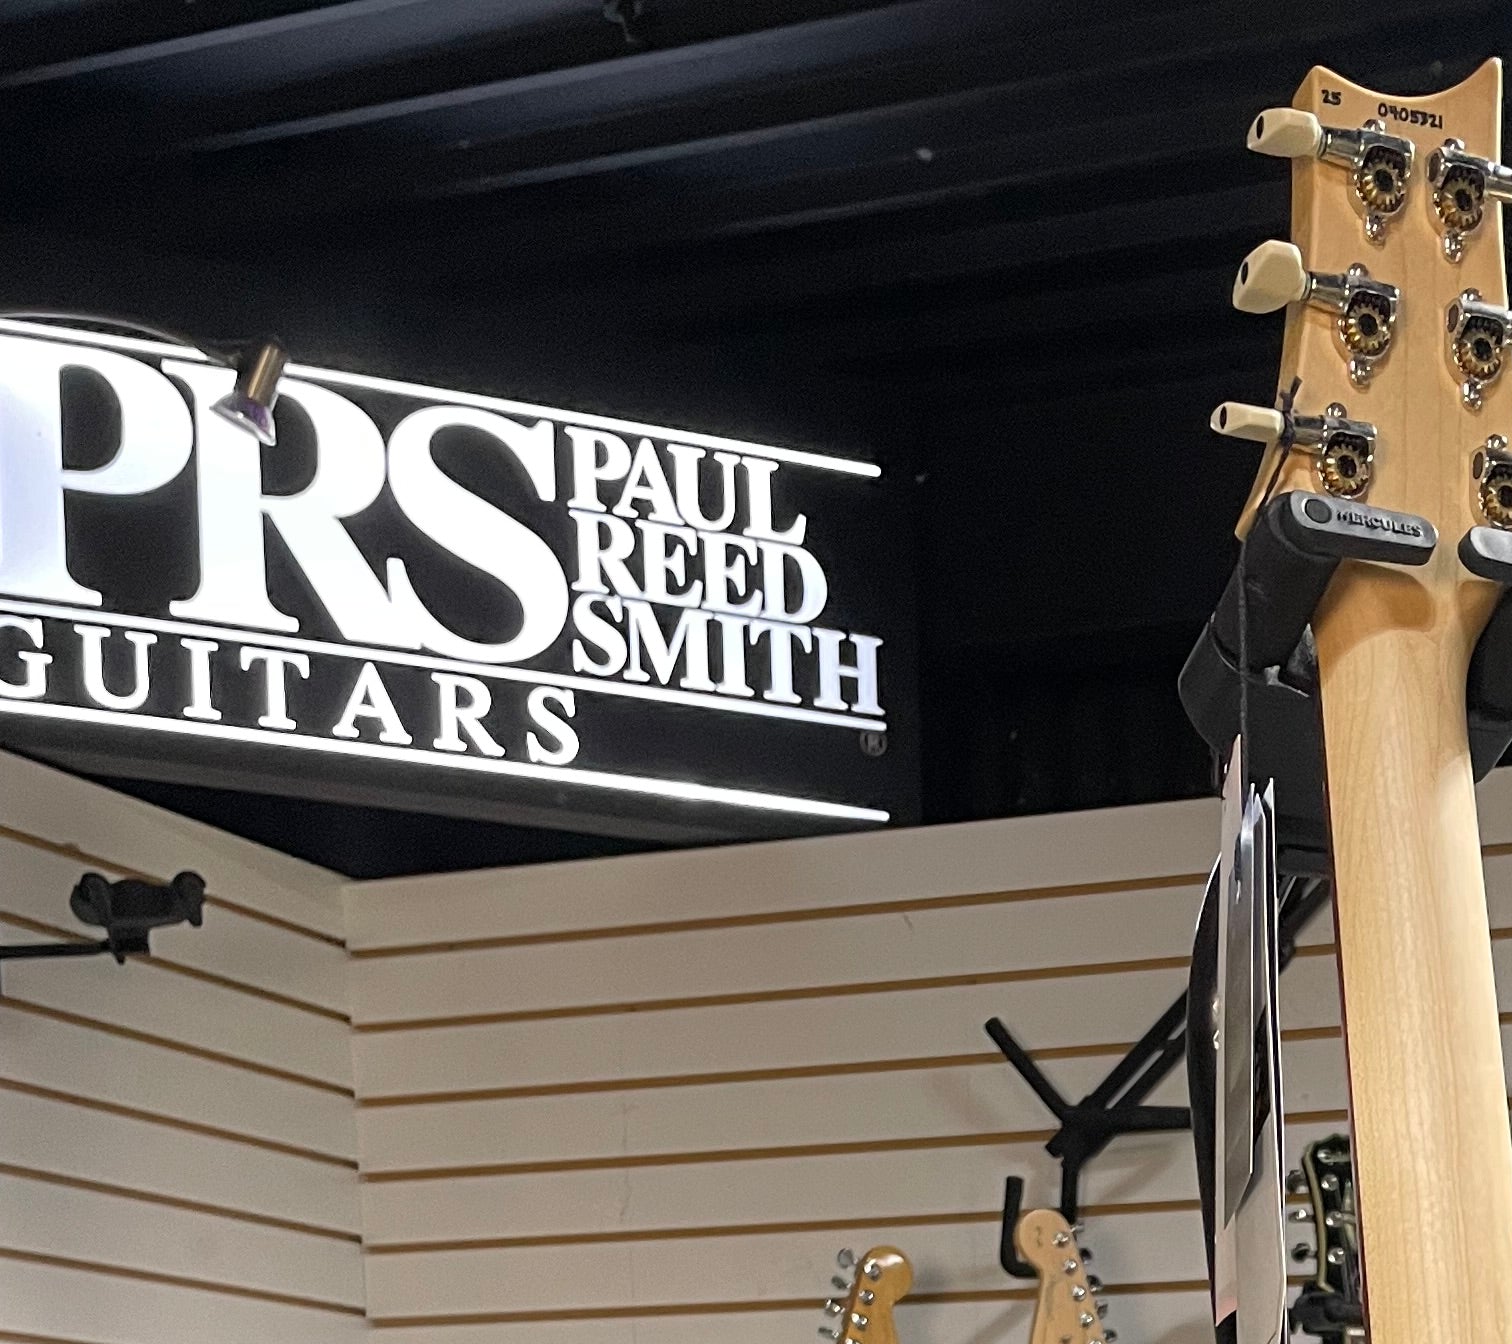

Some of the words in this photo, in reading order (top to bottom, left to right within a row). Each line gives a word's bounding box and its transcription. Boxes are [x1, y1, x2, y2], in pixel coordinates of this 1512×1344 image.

[1321, 89, 1342, 106] 25
[0, 326, 572, 664] PRS
[565, 424, 807, 546] PAUL
[1336, 510, 1422, 538] HERCULES
[570, 509, 829, 626] REED
[0, 614, 580, 767] GUITARS
[572, 592, 887, 719] SMITH
